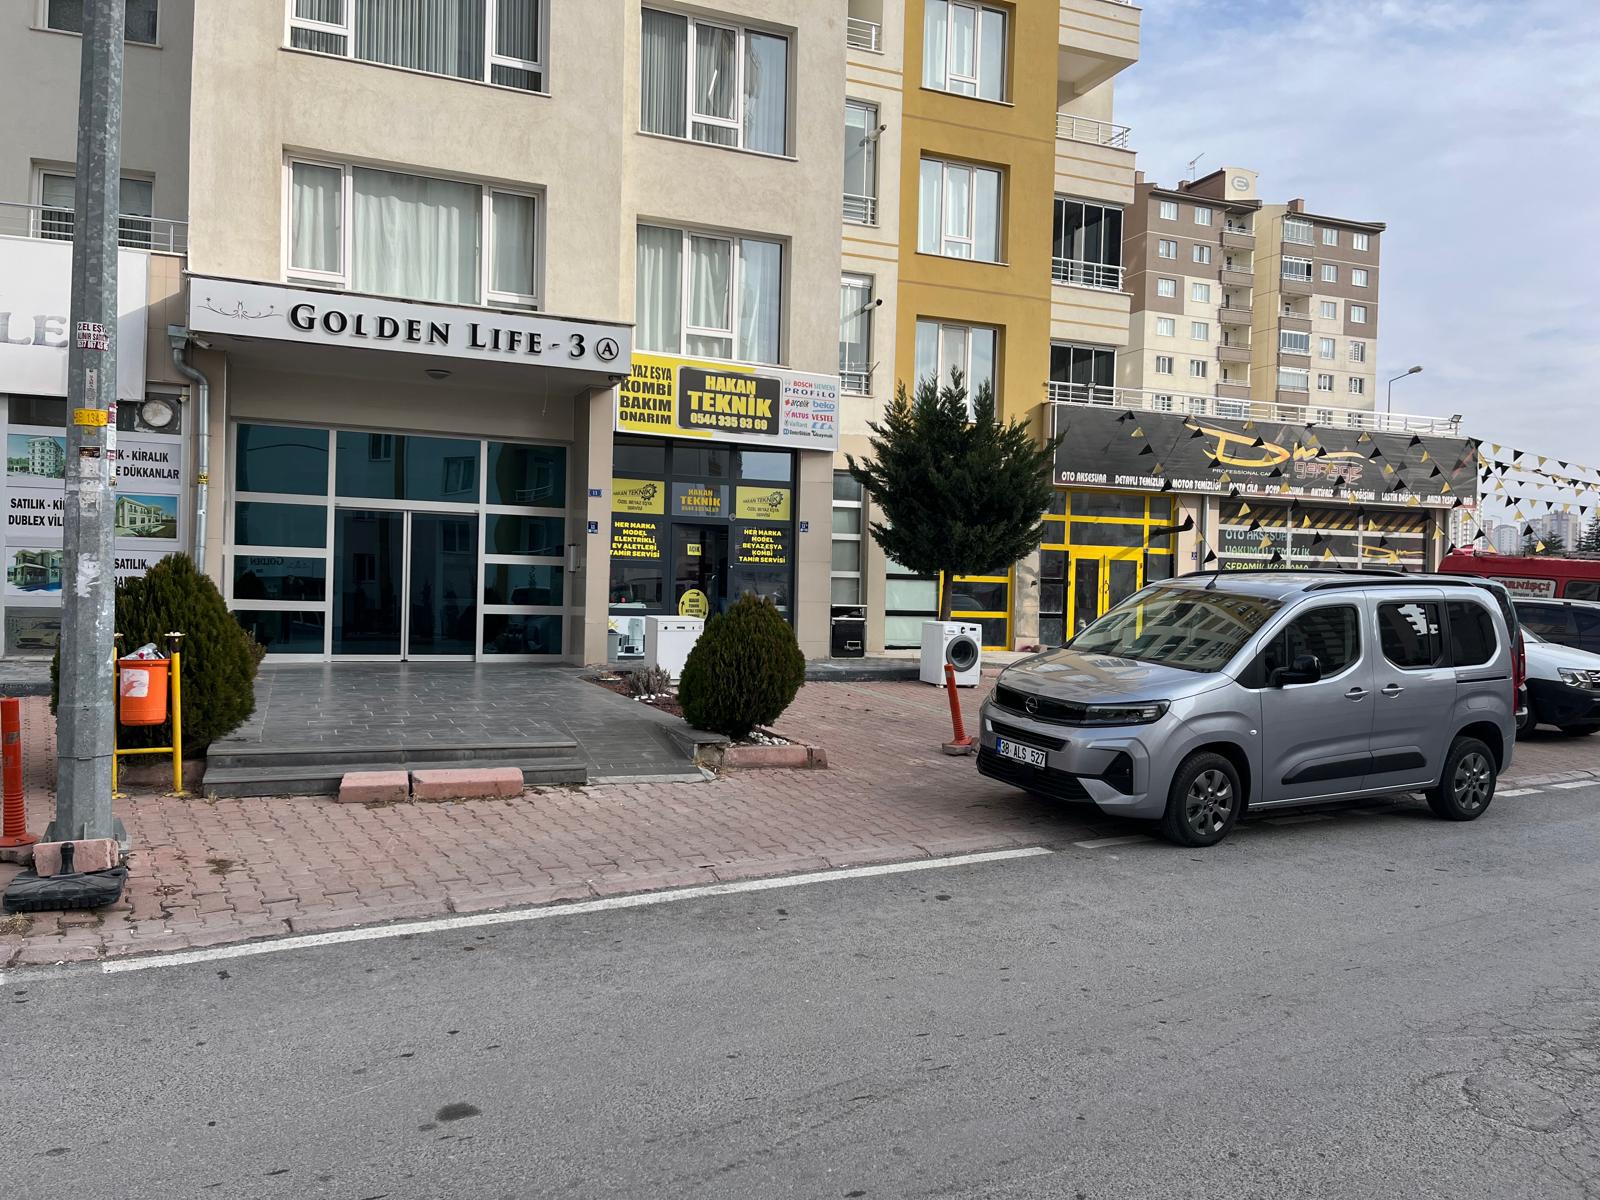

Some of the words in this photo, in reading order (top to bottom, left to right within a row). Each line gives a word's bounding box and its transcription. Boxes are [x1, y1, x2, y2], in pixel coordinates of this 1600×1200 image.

[290, 303, 452, 345] GOLDEN
[468, 322, 542, 355] LIFE
[569, 333, 585, 357] 3
[632, 364, 648, 378] YAZ
[650, 366, 672, 382] EŞYA
[620, 380, 672, 396] KOMBİ
[705, 375, 757, 394] HAKAN
[794, 380, 812, 388] BOSCH
[620, 395, 672, 412] BAKIM
[687, 390, 772, 418] TEKNİK
[813, 400, 835, 409] beko
[620, 410, 672, 424] ONARIM
[690, 412, 717, 426] 0544
[812, 414, 833, 422] VESTEL
[132, 448, 168, 462] KİRALIK
[123, 464, 180, 479] DÜKKANLAR
[1062, 472, 1075, 482] OTO
[1076, 473, 1107, 484] AKSESUAR
[1114, 474, 1138, 486] DETAYLI
[1172, 479, 1193, 488] MOTOR
[10, 498, 45, 510] SATILIK
[8, 514, 45, 526] DUBLEX
[1226, 530, 1244, 540] OTO
[115, 558, 147, 570] SATILIK
[1014, 745, 1026, 760] ALS
[1031, 750, 1044, 765] 527
